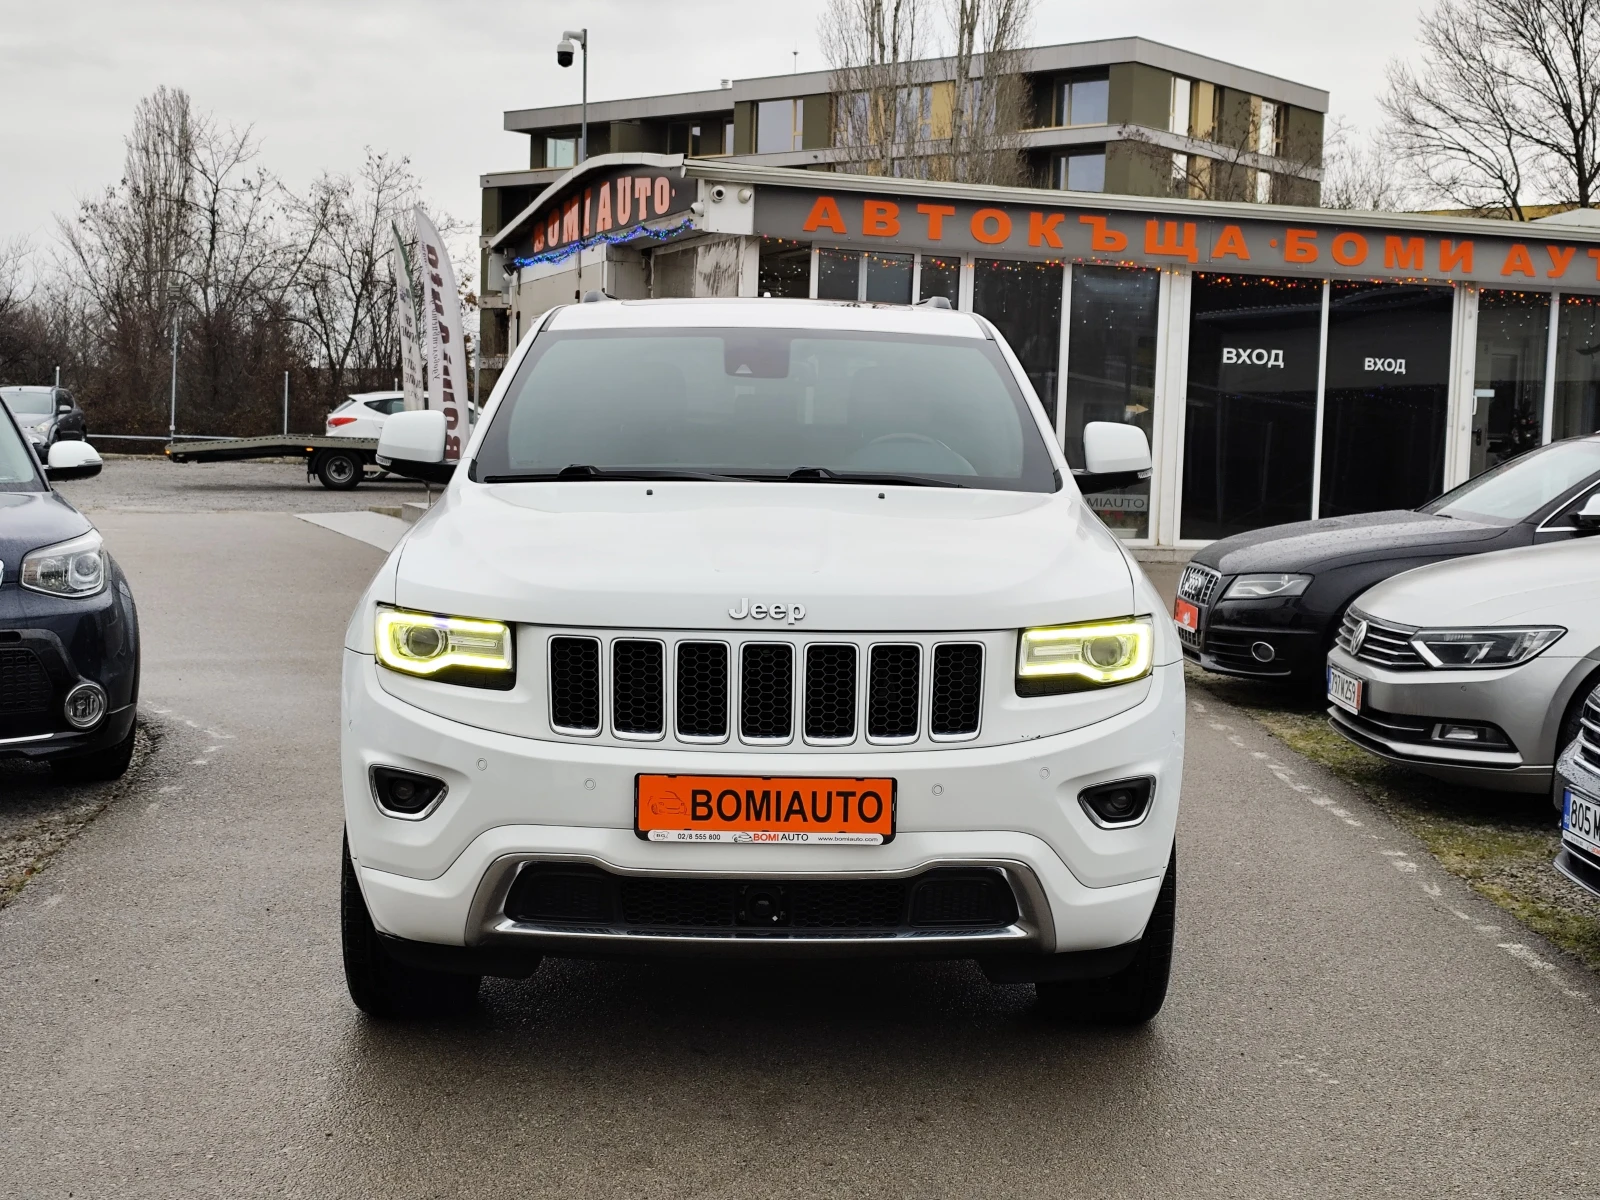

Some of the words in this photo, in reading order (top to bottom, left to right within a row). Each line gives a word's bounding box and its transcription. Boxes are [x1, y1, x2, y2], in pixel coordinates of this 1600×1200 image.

[534, 177, 669, 252] BOMIAUTO
[802, 196, 1251, 264] АВТОКЪЩА
[1284, 228, 1474, 273] БОМИ
[1222, 347, 1285, 368] ВХОД
[1364, 357, 1406, 374] ВХОД
[728, 597, 806, 625] Jeep
[691, 790, 882, 823] BOMIAUTO
[708, 833, 721, 841] 800
[753, 833, 780, 842] BOMI
[780, 833, 809, 842] AUTO
